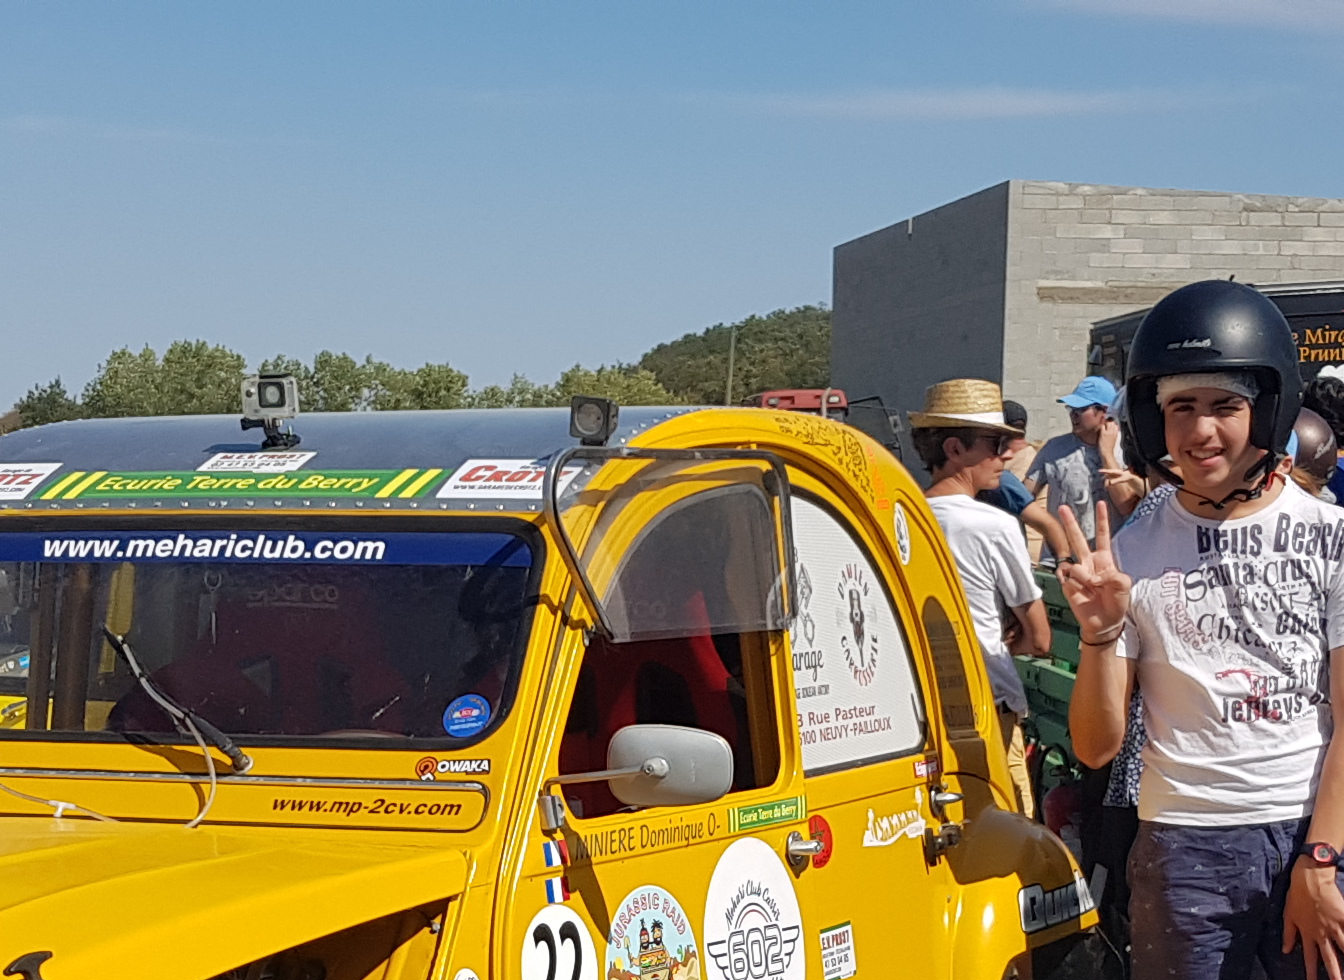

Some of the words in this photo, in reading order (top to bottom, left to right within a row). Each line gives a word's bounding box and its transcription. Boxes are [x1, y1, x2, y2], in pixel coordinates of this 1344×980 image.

[96, 476, 182, 491] Ecurie
[186, 475, 255, 489] Terre
[257, 475, 298, 489] du
[298, 475, 380, 492] Berry
[43, 533, 386, 560] www.mehariclub.com
[1183, 561, 1256, 608] Santa
[792, 649, 824, 682] arage
[808, 711, 830, 726] Rue
[834, 704, 876, 722] Pasteur
[819, 716, 892, 742] NEUVY-PAILLOUX
[437, 759, 490, 773] OWAKA
[272, 798, 462, 817] www.mp-2cv.com
[639, 817, 704, 848] Dominique
[746, 879, 761, 897] Club
[612, 892, 660, 949] JURASSIC
[662, 897, 686, 935] RAID
